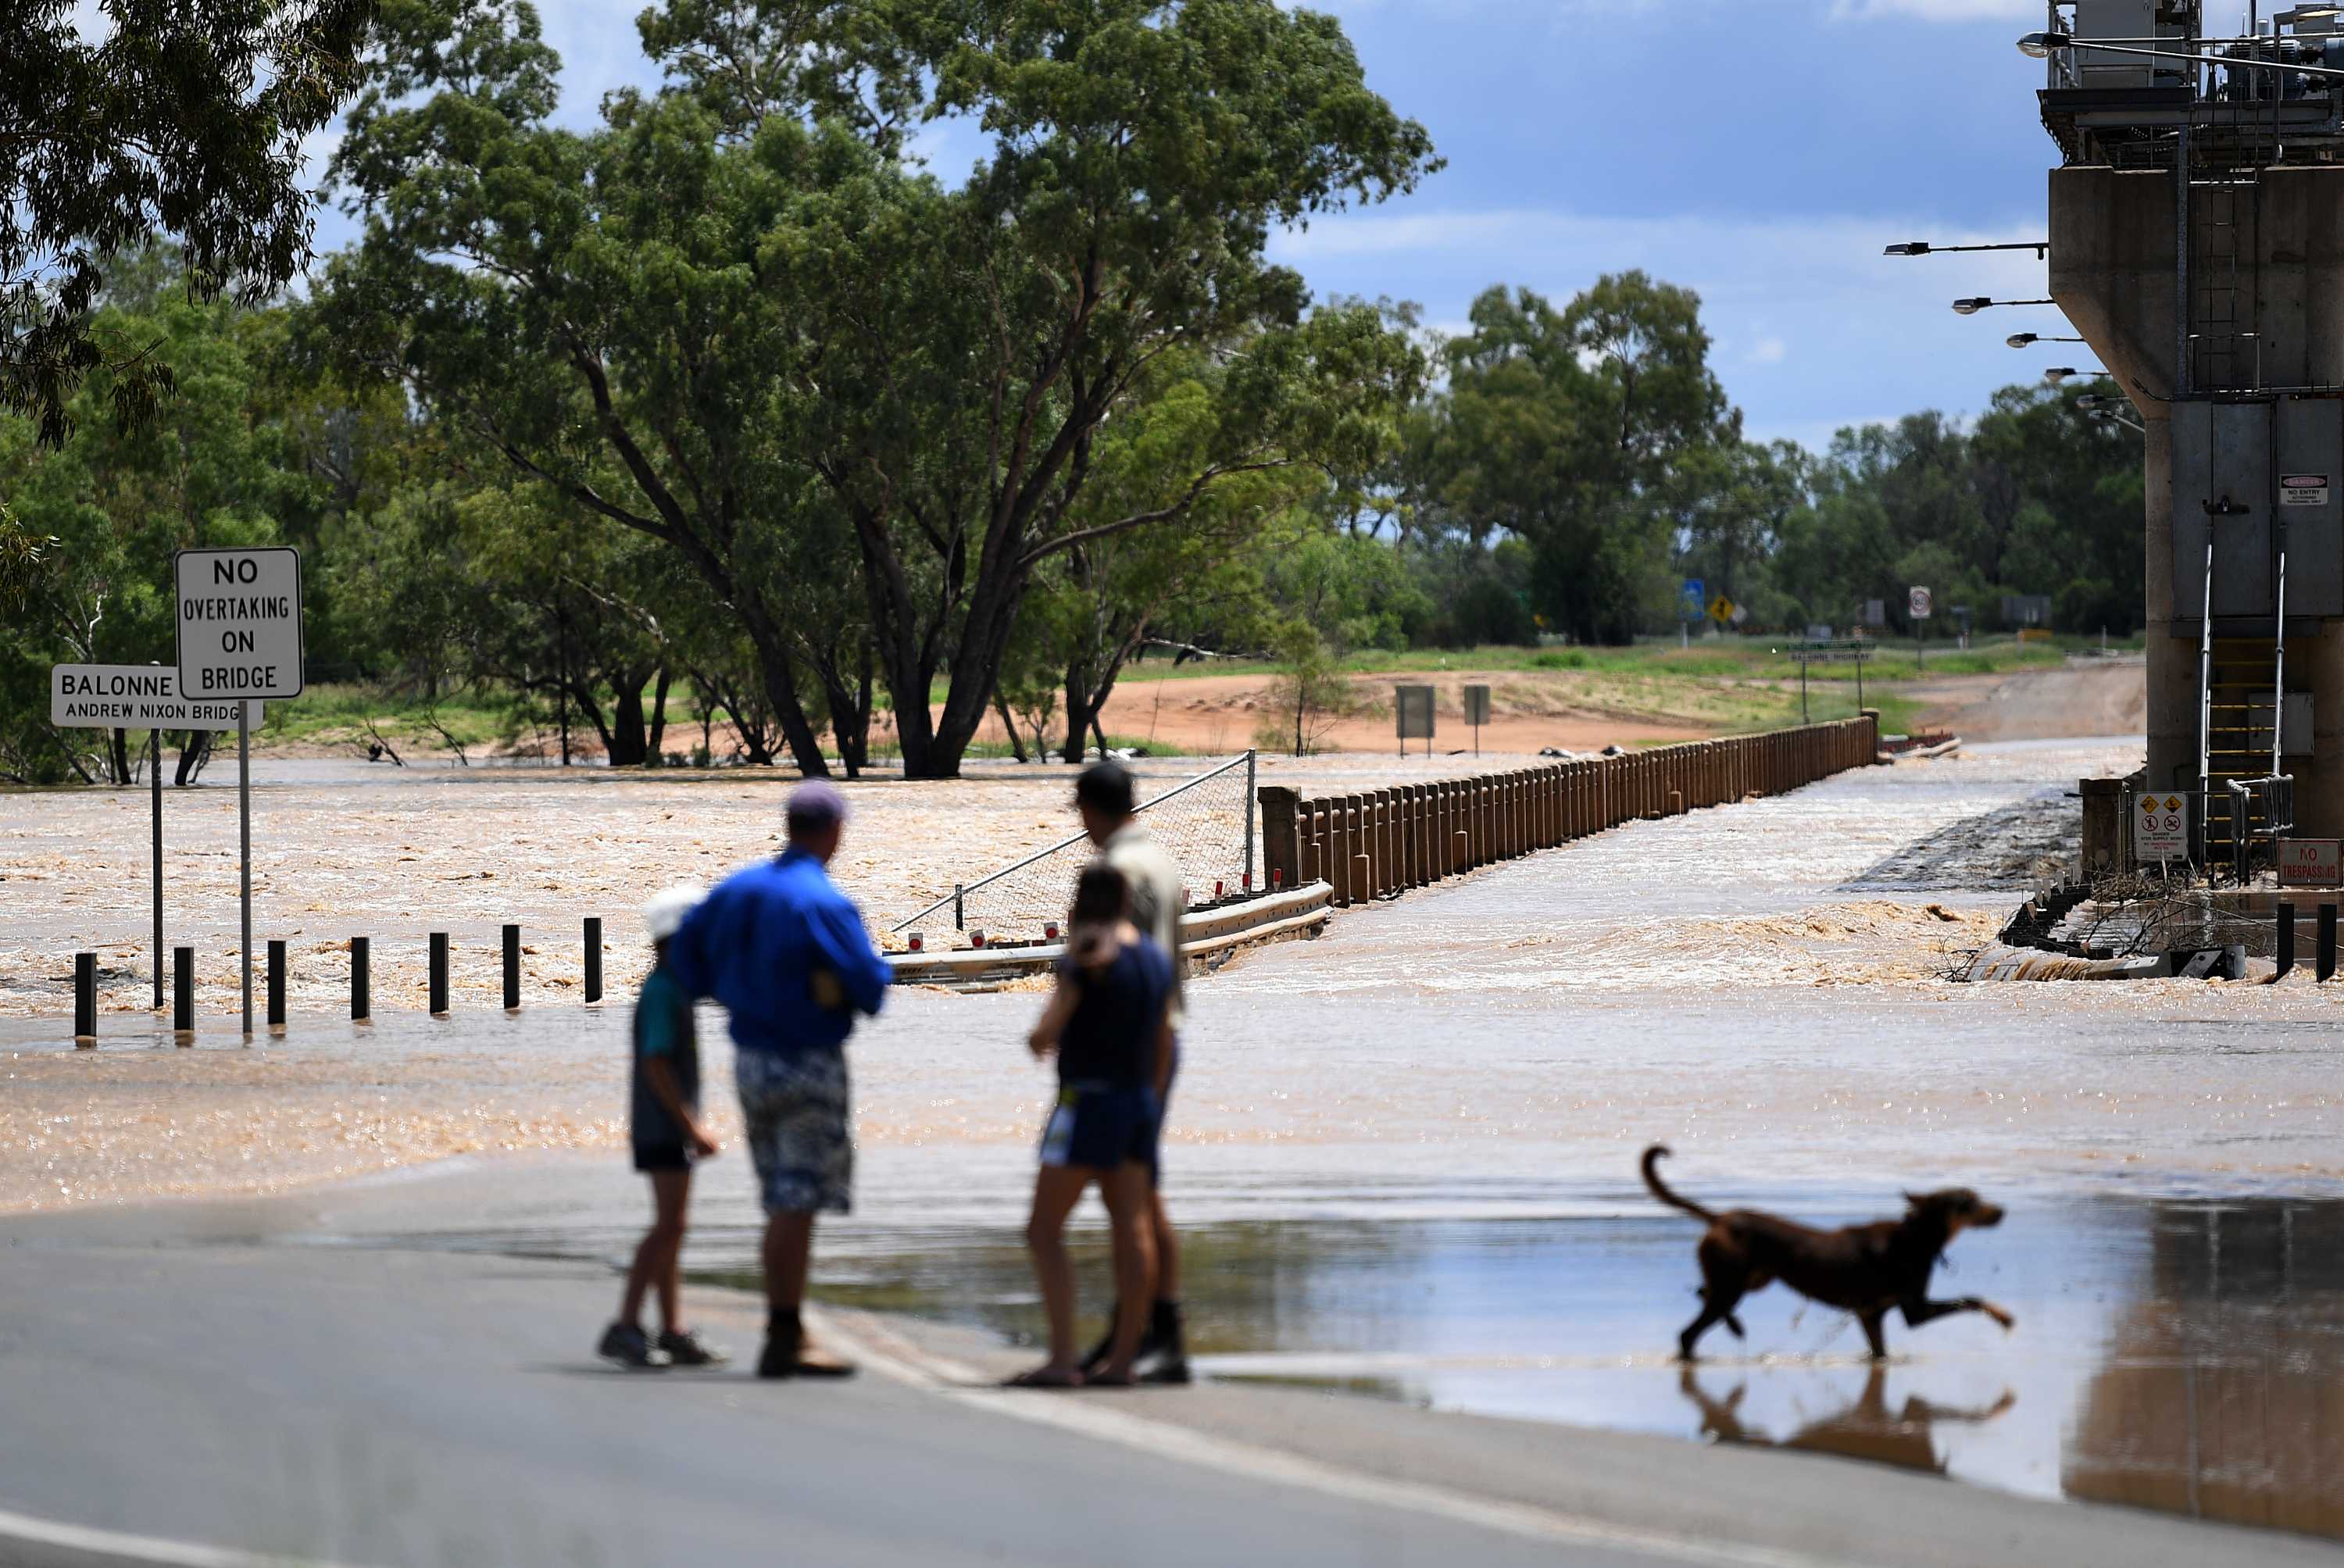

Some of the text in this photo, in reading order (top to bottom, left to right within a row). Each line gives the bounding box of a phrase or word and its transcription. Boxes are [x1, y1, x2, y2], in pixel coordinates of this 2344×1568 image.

[214, 559, 258, 584] NO
[184, 596, 289, 620] OVERTAKING
[222, 630, 255, 653] ON
[62, 675, 173, 696] BALONNE
[202, 666, 277, 690] BRIDGE
[66, 702, 239, 720] ANDREW NIXON BRIDG
[2300, 848, 2317, 862] NO
